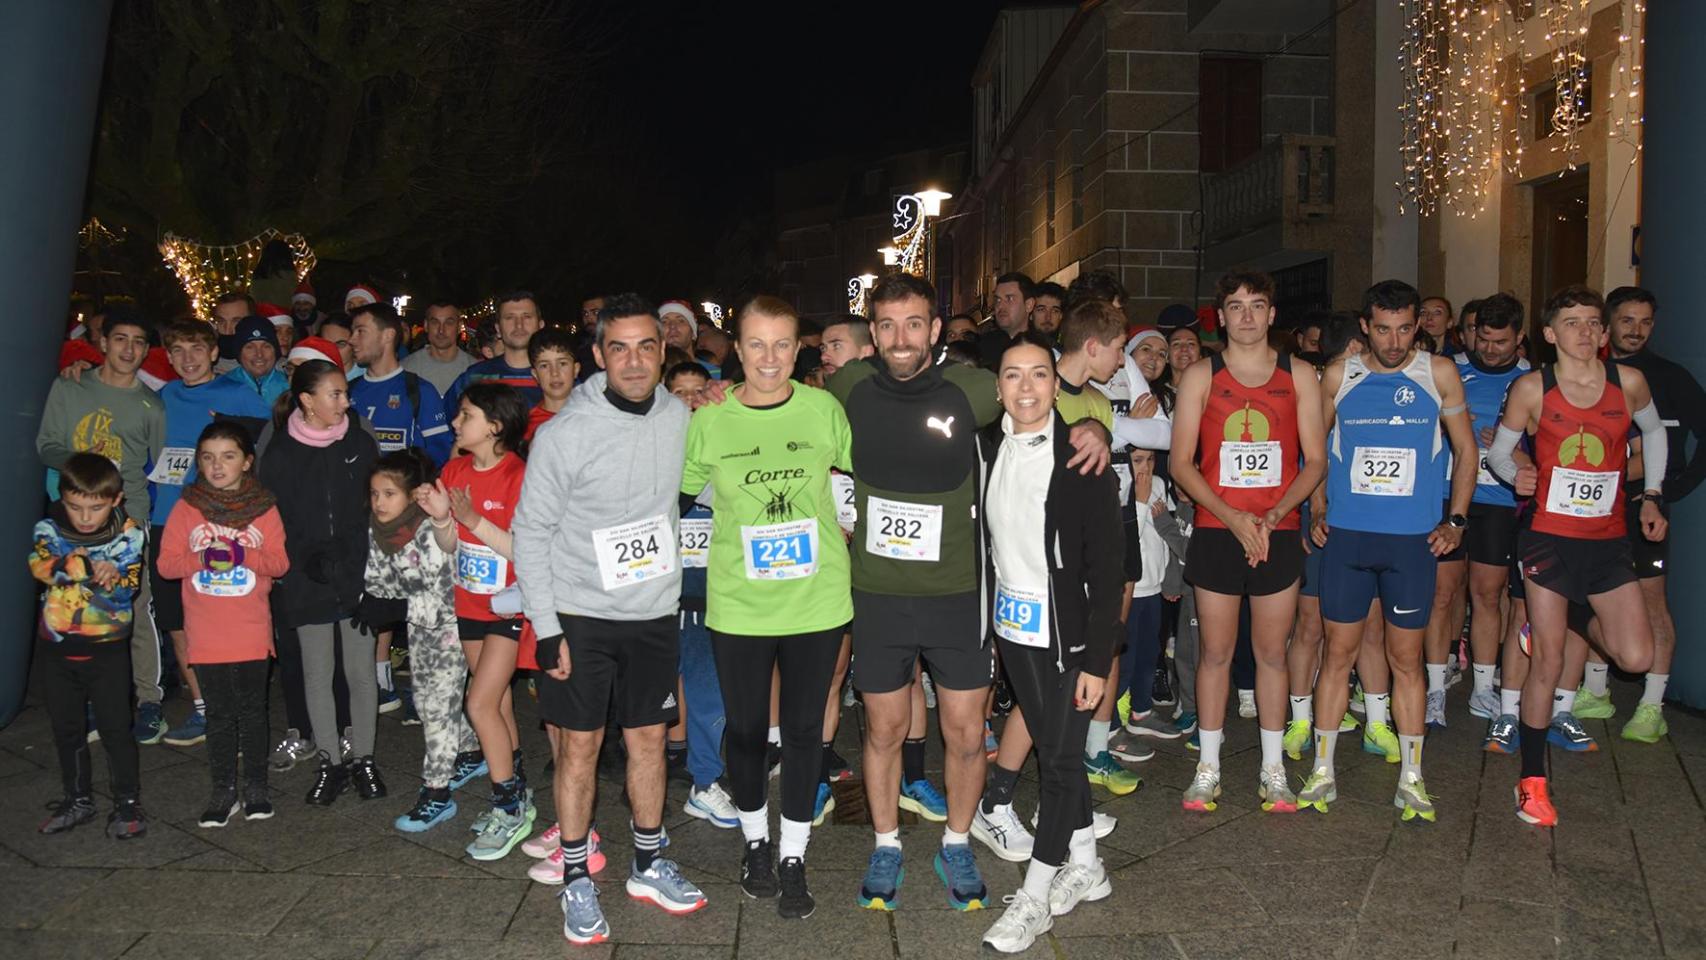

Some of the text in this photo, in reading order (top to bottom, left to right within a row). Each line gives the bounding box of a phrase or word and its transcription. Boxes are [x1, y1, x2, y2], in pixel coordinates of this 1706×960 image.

[367, 406, 376, 420] 7
[166, 457, 190, 472] 144
[1234, 453, 1269, 471] 192
[1363, 460, 1401, 478] 322
[743, 467, 805, 485] Corre
[1567, 482, 1604, 501] 196
[880, 515, 922, 540] 282
[614, 534, 660, 564] 284
[758, 536, 802, 562] 221
[460, 556, 490, 578] 263
[998, 596, 1033, 625] 219
